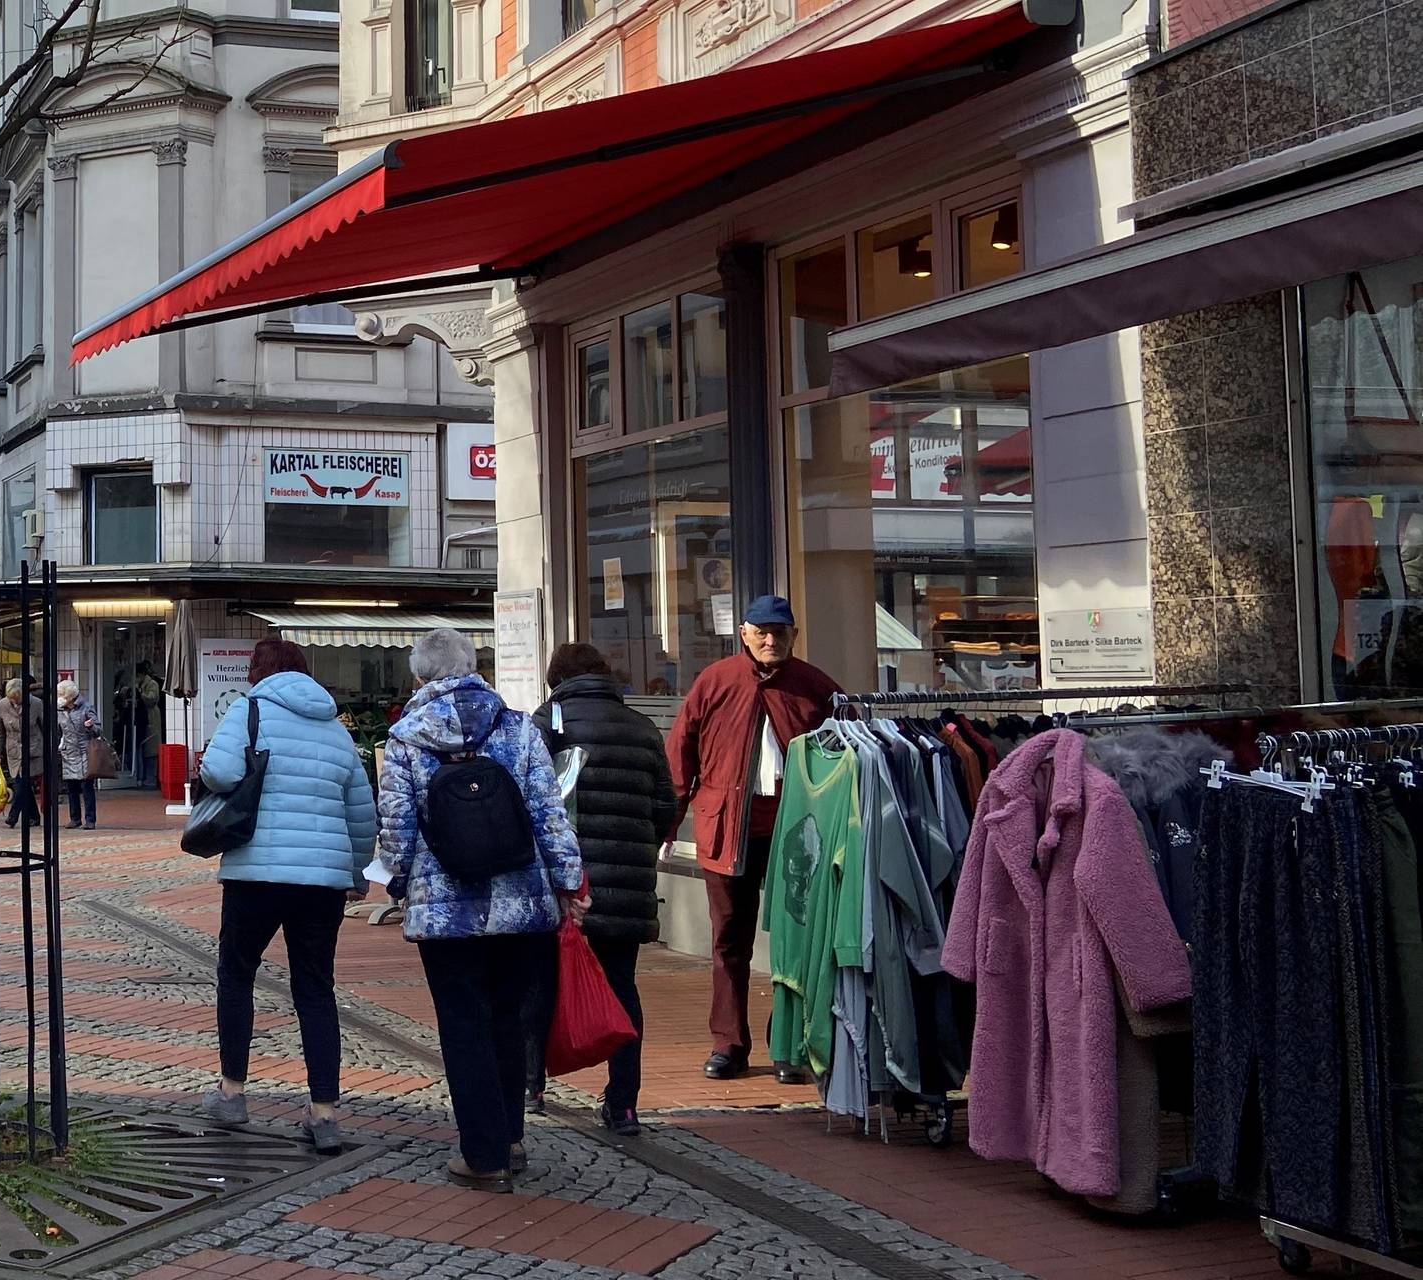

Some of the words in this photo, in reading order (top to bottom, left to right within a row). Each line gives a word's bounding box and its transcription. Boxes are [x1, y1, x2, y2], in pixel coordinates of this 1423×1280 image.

[269, 453, 319, 475] KARTAL
[322, 454, 402, 478] FLEISCHEREI
[270, 487, 309, 497] Fleischerei
[374, 489, 401, 500] Kasap
[1050, 639, 1063, 647] Dirk
[1064, 638, 1090, 647] Barteck
[1114, 636, 1142, 645] Barteck
[216, 664, 249, 672] Herzlich
